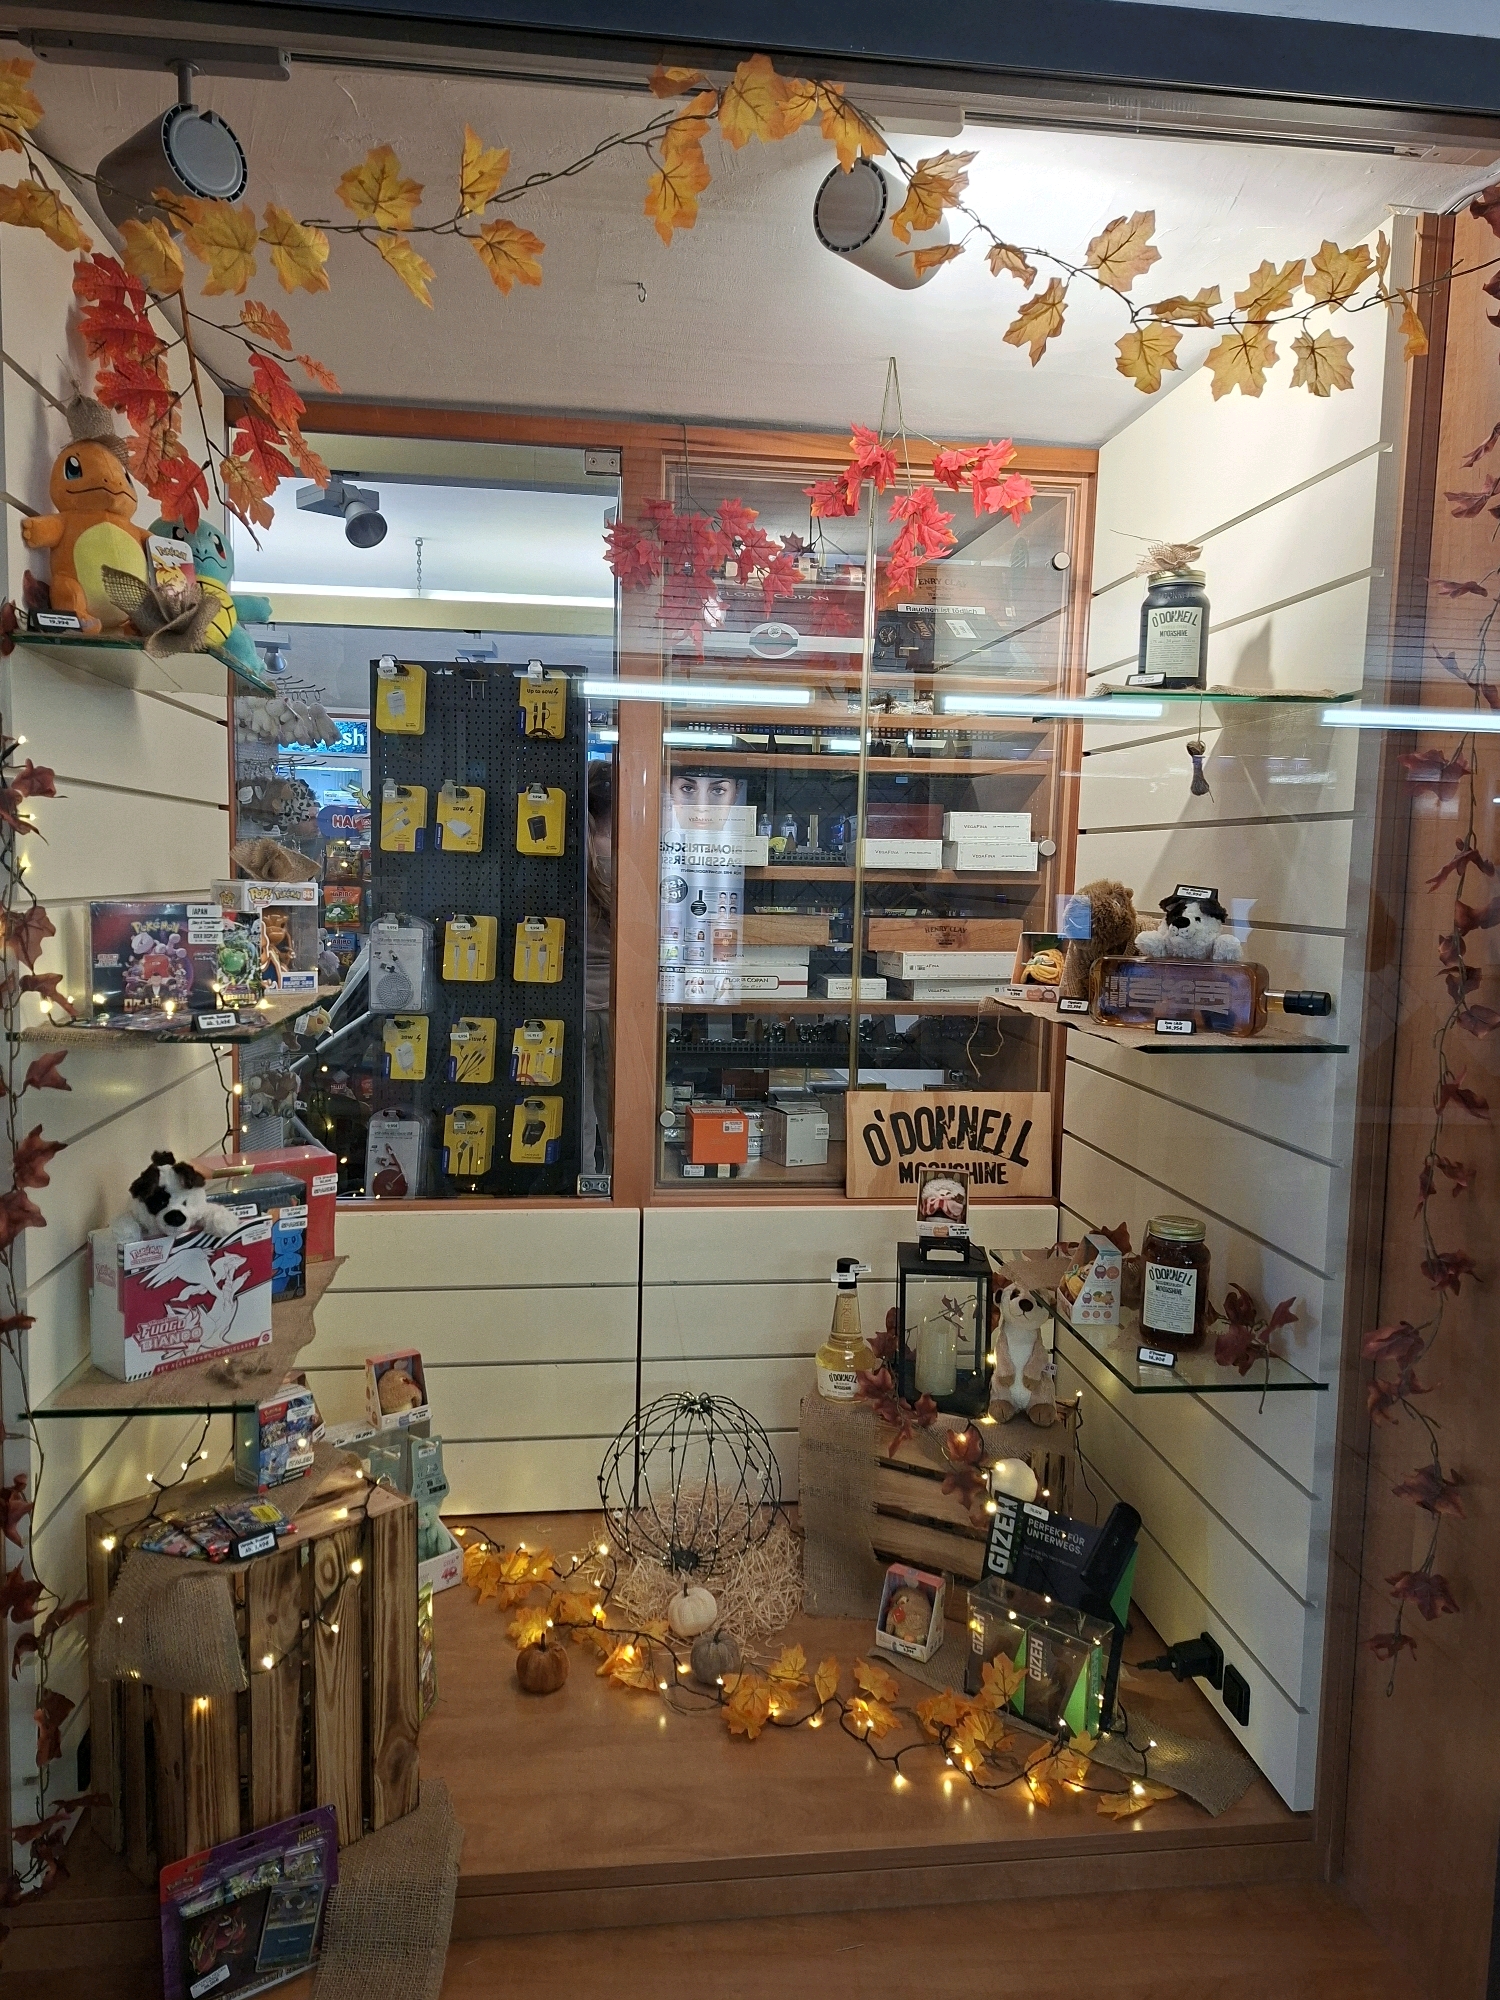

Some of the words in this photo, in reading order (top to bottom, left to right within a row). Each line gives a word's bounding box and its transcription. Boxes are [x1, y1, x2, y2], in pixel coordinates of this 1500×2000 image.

[918, 577, 941, 586] ENRY
[905, 605, 939, 613] Rauchen
[1152, 609, 1199, 628] O'DONNELL
[862, 1104, 1033, 1168] O'DONNELL
[1148, 1266, 1193, 1287] O'DONNELL
[987, 1495, 1019, 1575] GIZEH
[1026, 1526, 1083, 1556] UNTERWEGS.
[1027, 1517, 1067, 1539] PERFEKT
[1067, 1532, 1085, 1547] FÜR
[972, 1612, 985, 1656] GIZEH
[1028, 1636, 1044, 1682] GIZEH
